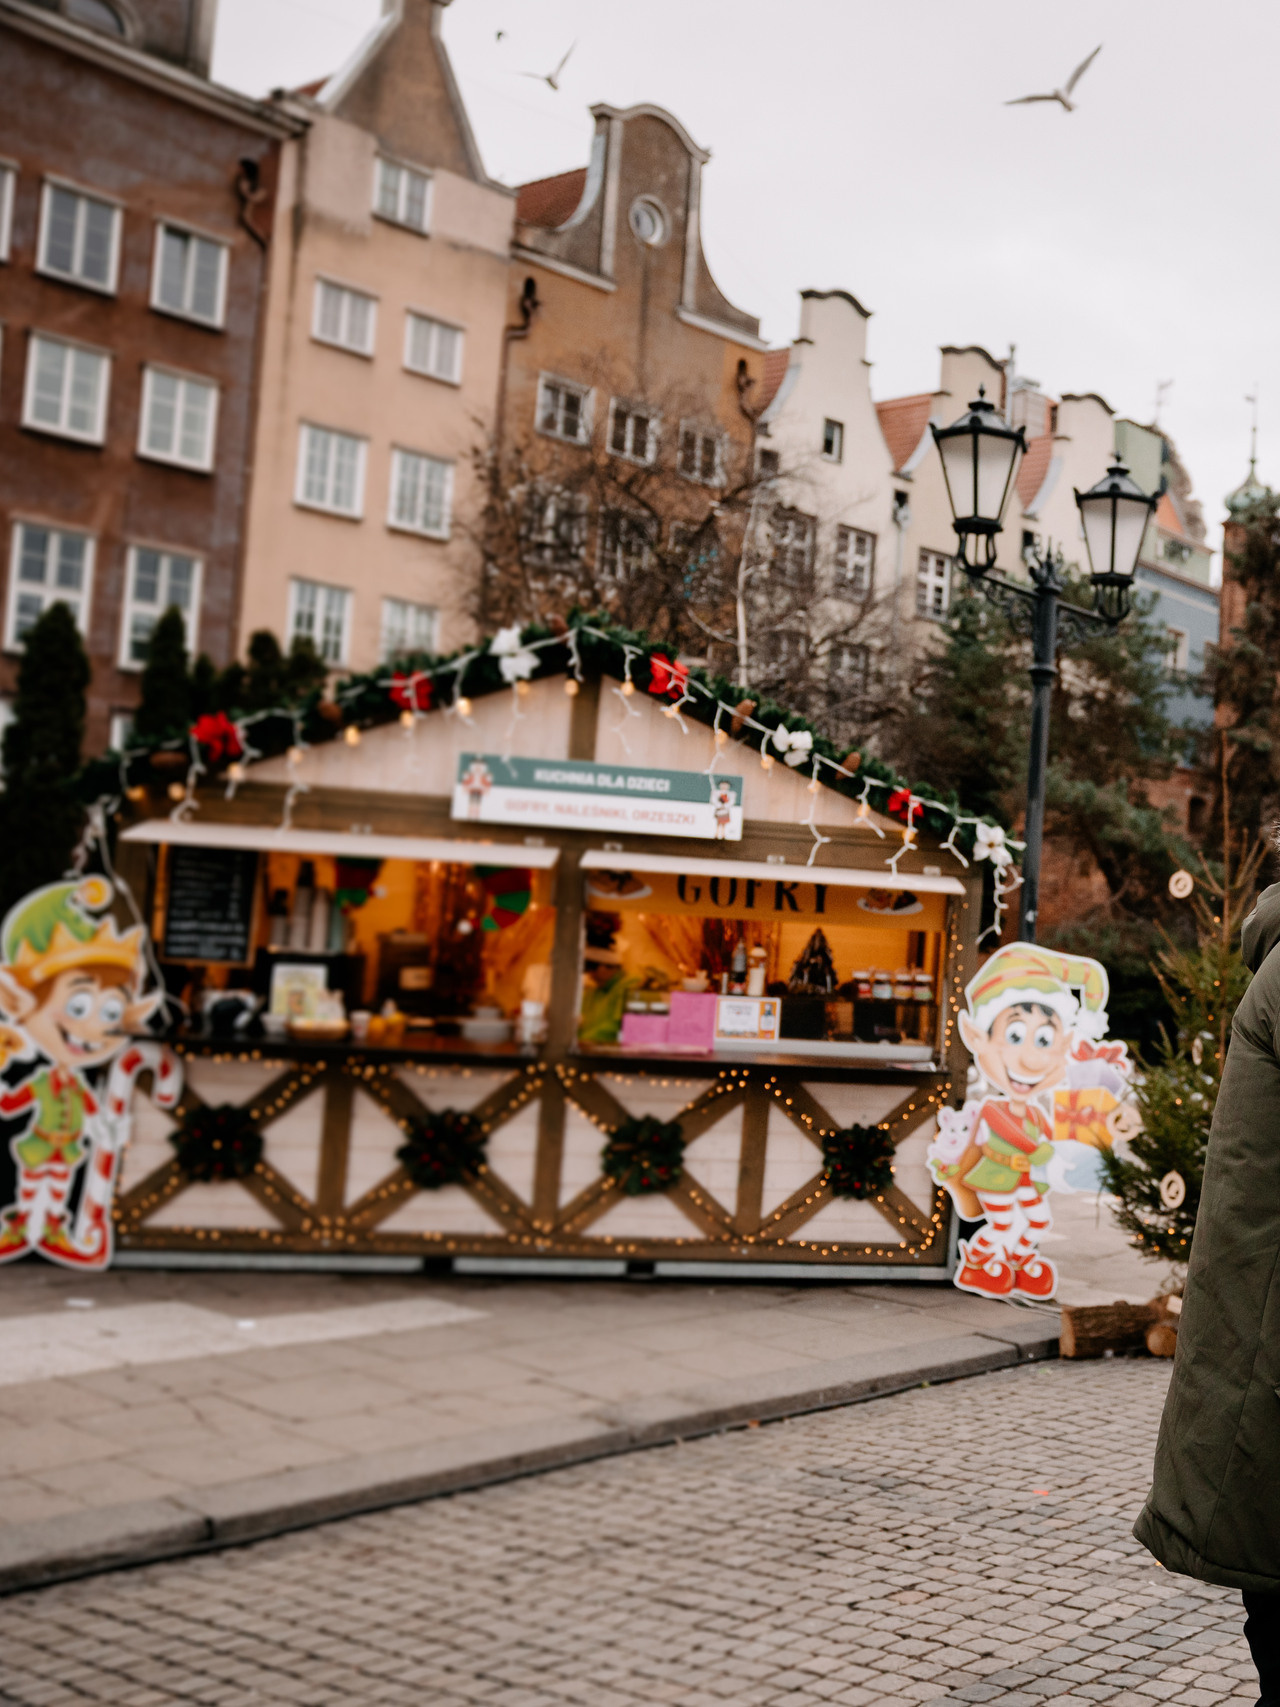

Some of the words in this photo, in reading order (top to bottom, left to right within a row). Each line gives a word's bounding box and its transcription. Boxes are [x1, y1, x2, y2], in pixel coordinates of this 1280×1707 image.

[534, 768, 594, 786] KUCHNIA
[597, 773, 625, 789] DLA
[627, 776, 671, 793] DZIECI
[632, 809, 696, 825] ORZESZKI
